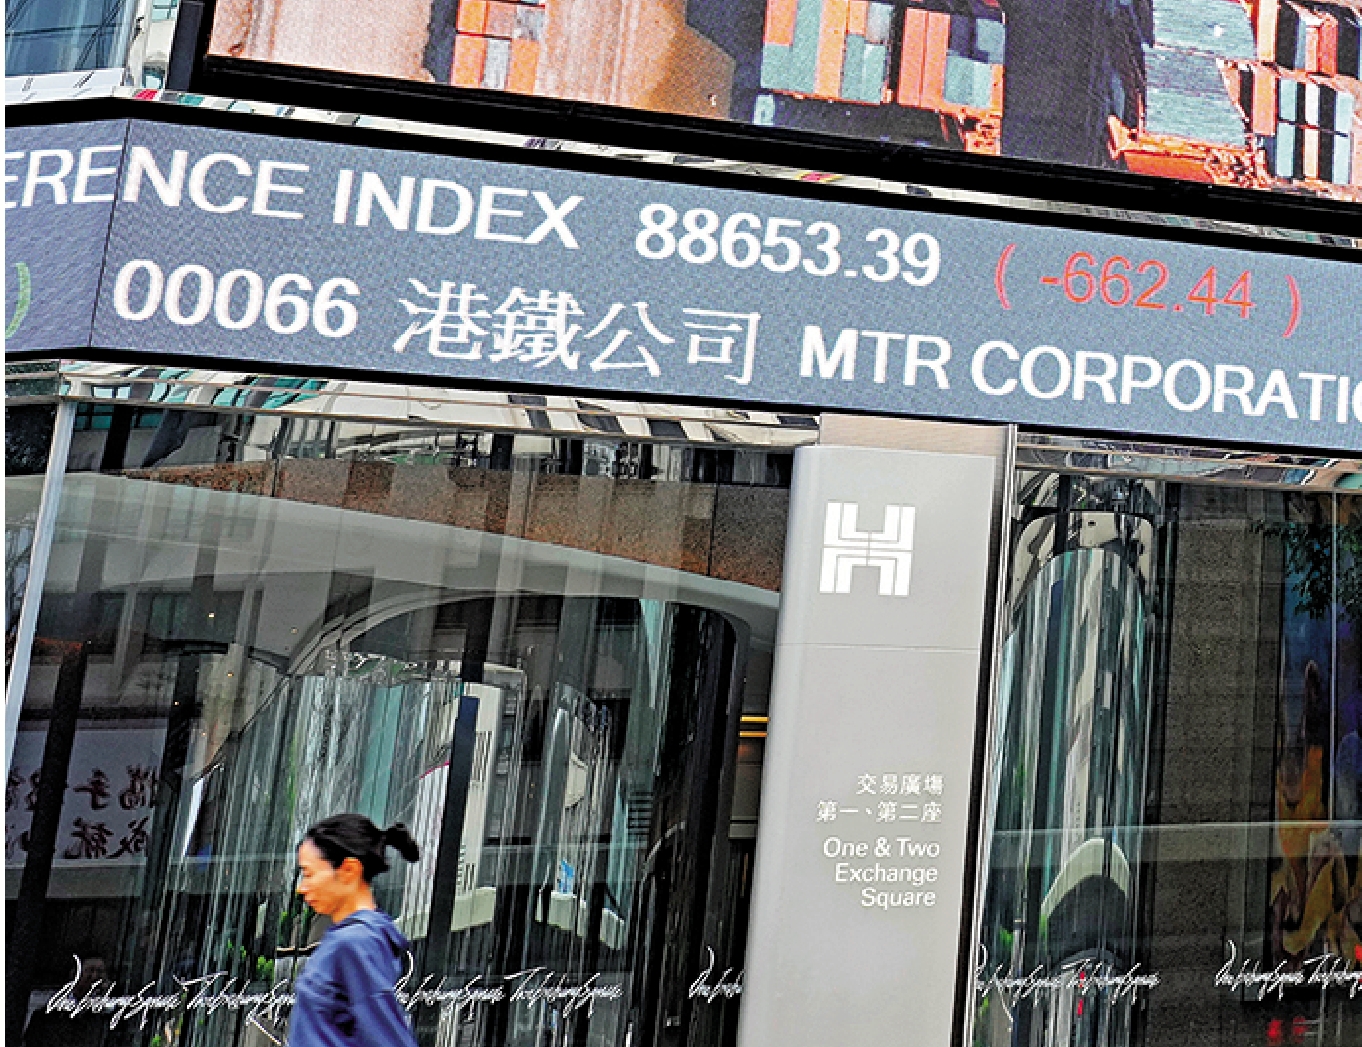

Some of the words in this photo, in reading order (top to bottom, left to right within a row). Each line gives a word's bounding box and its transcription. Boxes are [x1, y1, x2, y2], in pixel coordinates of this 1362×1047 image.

[332, 169, 585, 250] INDEX
[635, 203, 942, 287] 88653.39
[113, 258, 361, 338] 00066
[393, 277, 761, 385] 港鐵公司
[800, 325, 951, 390] MTR
[823, 836, 869, 858] One
[874, 836, 891, 858] &
[897, 836, 940, 858] Two
[835, 862, 938, 886] Exchange
[861, 886, 936, 911] Square
